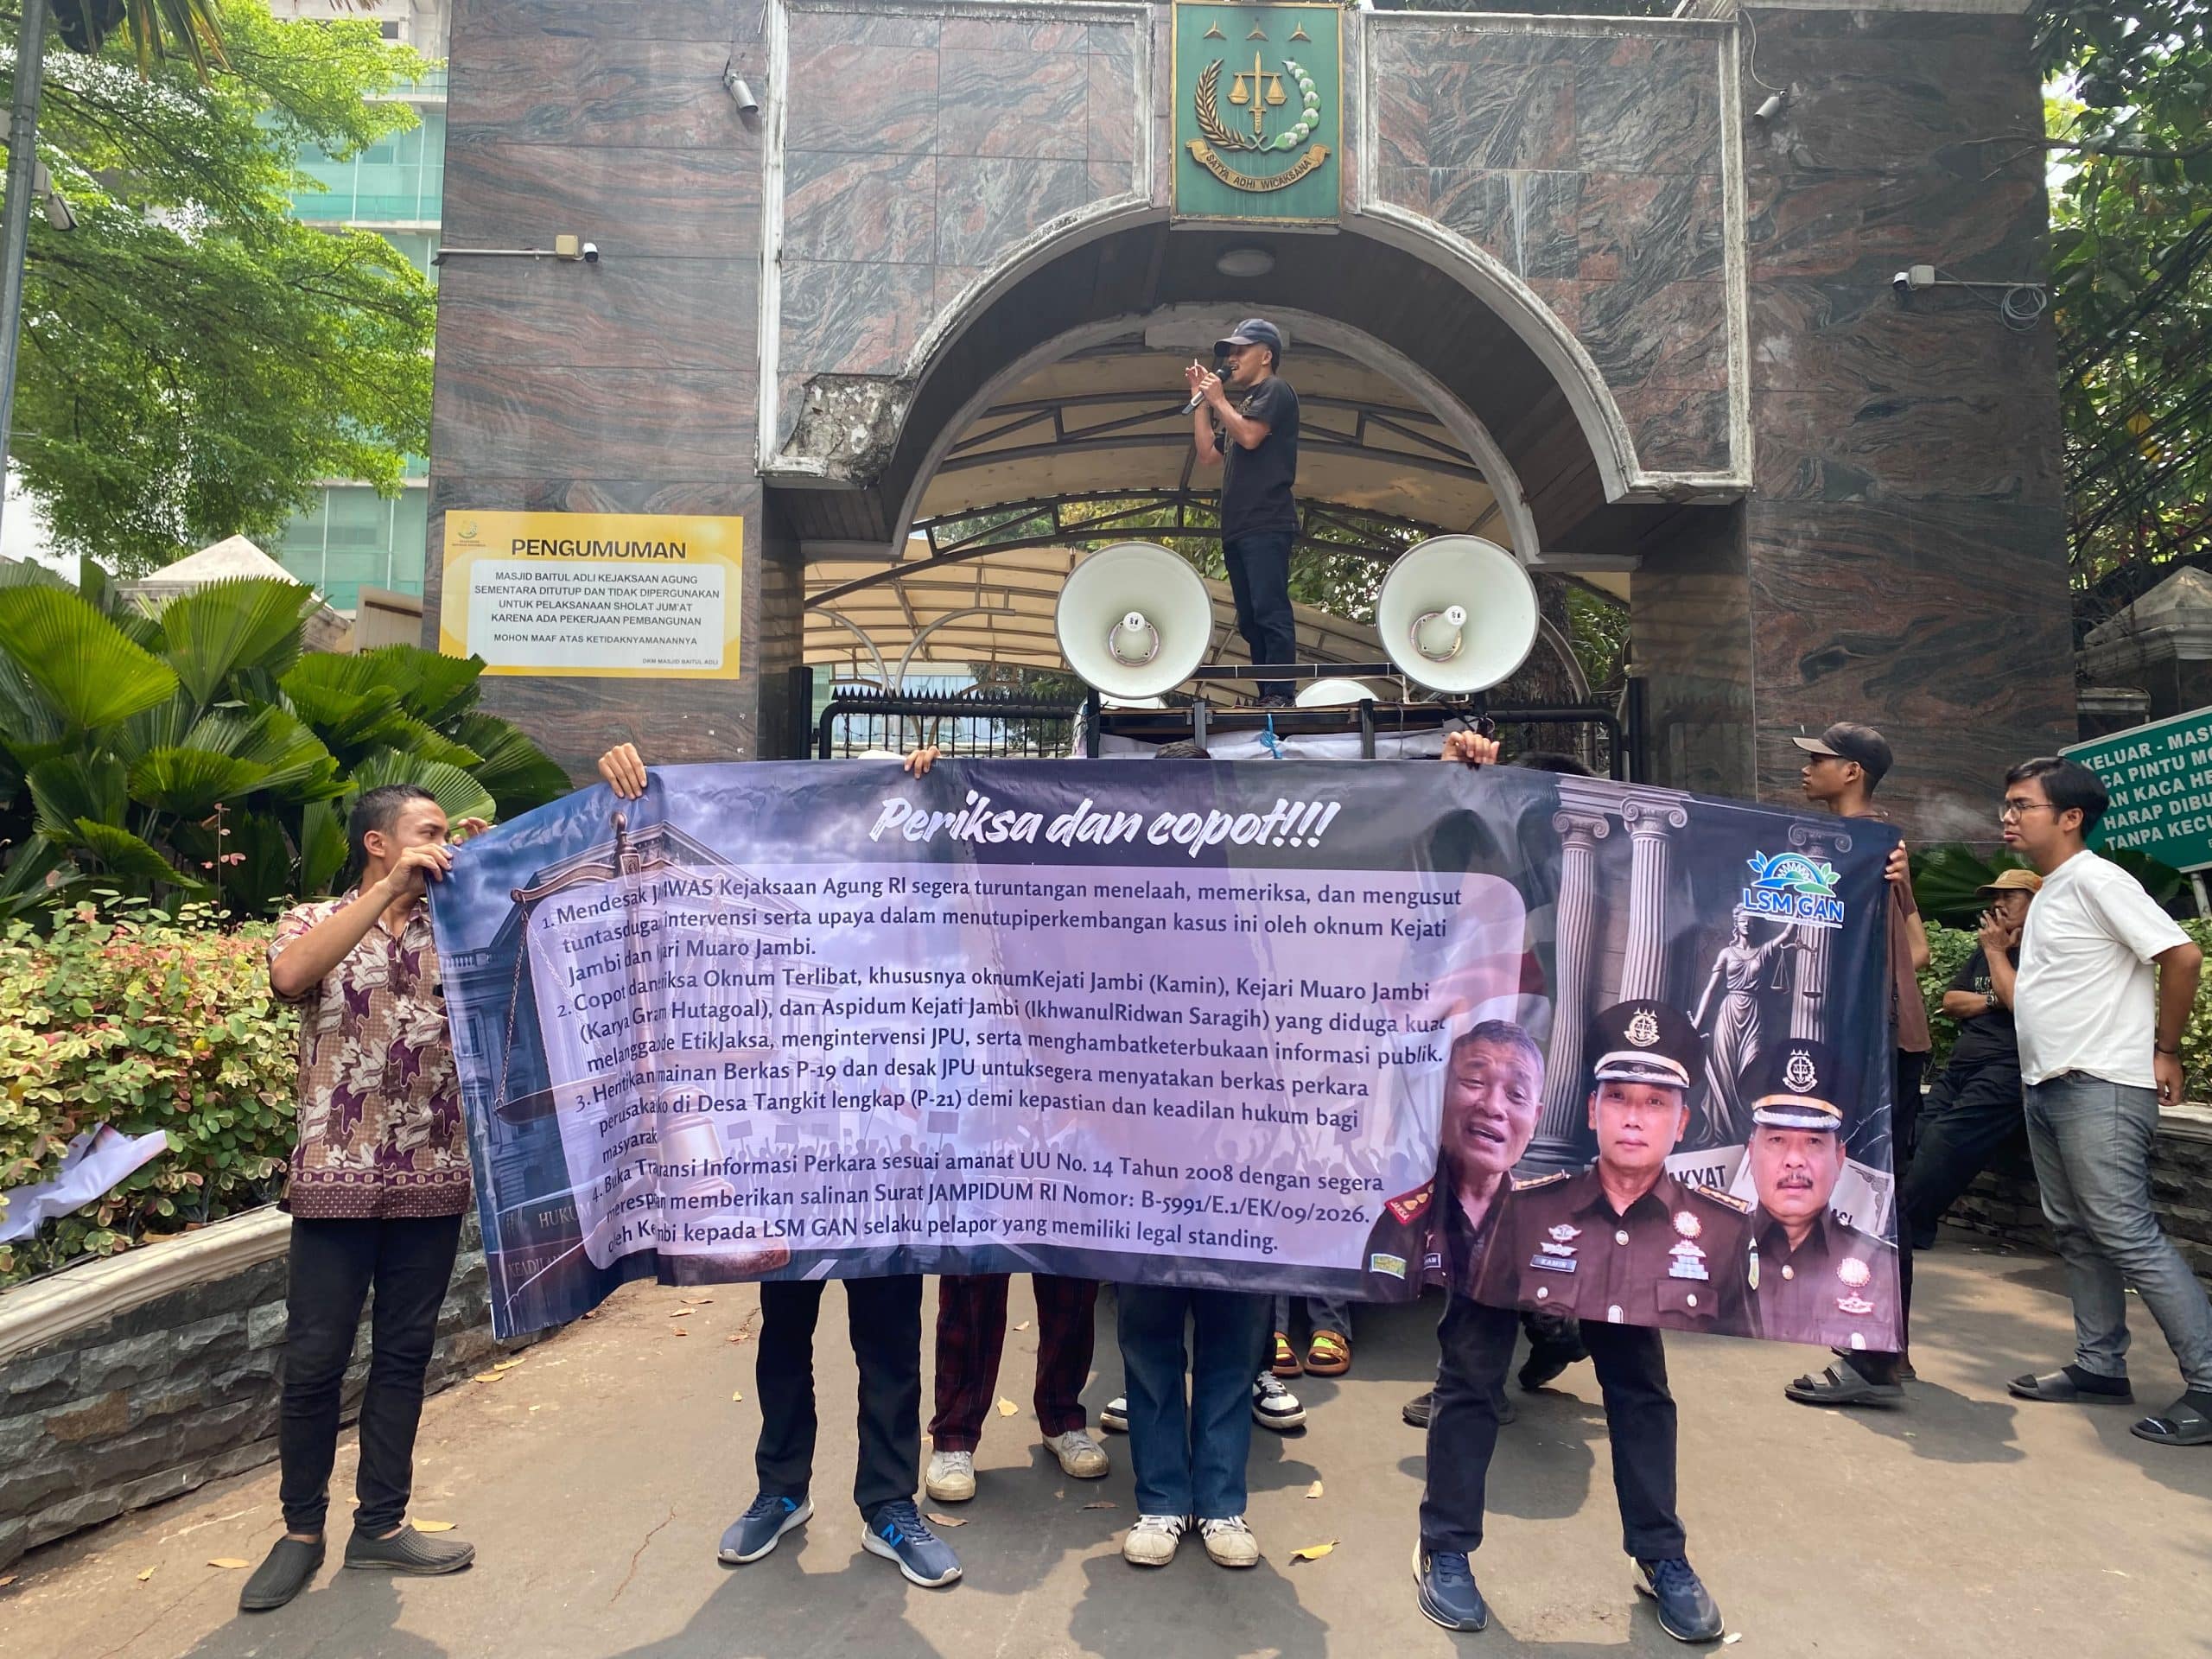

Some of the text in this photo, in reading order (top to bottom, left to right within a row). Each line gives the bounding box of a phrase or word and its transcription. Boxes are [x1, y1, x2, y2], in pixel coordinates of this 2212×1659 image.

[1206, 153, 1311, 189] SATYA ADHI WICAKSANA
[512, 539, 685, 558] PENGUMUMAN
[475, 586, 537, 594] SEMENTARA
[539, 587, 582, 595] DITUTUP
[607, 588, 637, 596] TIDAK
[640, 588, 719, 598] DIPERGUNAKAN
[496, 572, 532, 581] MASJID
[598, 574, 658, 583] KEJAKSAAN
[661, 575, 697, 584] AGUNG
[492, 613, 533, 622] KARENA
[560, 615, 620, 624] PEKERJAAN
[623, 616, 701, 626] PEMBANGUNAN
[499, 600, 533, 608] UNTUK
[537, 601, 611, 610] PELAKSANAAN
[587, 636, 697, 645] KETIDAKNYAMANANNYA
[2167, 726, 2212, 750] MAS
[2128, 754, 2185, 782] PINTU
[2133, 778, 2185, 802] KACA
[869, 790, 1341, 858] Periksa dan copot!!!
[2103, 804, 2163, 830] HARAP
[2105, 827, 2164, 851] TANPA
[543, 877, 1461, 929] 1. Mendesak Kejaksaan Agung RI segera turuntangan menelaah, memeriksa, dan mengusut
[1743, 888, 1793, 914] LSM
[1797, 897, 1844, 922] GAN
[663, 908, 756, 927] intervensi
[764, 907, 812, 925] serta
[819, 912, 875, 929] upaya
[880, 906, 935, 924] dalam
[1174, 912, 1226, 931] kasus
[1235, 914, 1257, 932] ini
[1264, 914, 1306, 933] oleh
[1313, 916, 1382, 936] oknum
[1391, 918, 1446, 941] Kejati
[569, 953, 620, 987] Jambi
[625, 949, 652, 968] dan
[687, 940, 749, 957] Muaro
[754, 938, 816, 960] Jambi.
[556, 1004, 571, 1017] 2.
[575, 986, 626, 1011] Copot
[629, 977, 656, 995] dan
[704, 969, 774, 987] Oknum
[782, 967, 861, 990] Terlibat,
[869, 966, 966, 988] khususnya
[1090, 972, 1142, 993] Jambi
[1150, 975, 1229, 997] (Kamin),
[1237, 977, 1293, 1001] Kejari
[1300, 980, 1366, 999] Muaro
[1371, 982, 1429, 1004] Jambi
[581, 1017, 630, 1044] (Karya
[672, 999, 774, 1022] Hutagoal),
[780, 999, 815, 1016] dan
[823, 996, 906, 1020] Aspidum
[912, 996, 963, 1019] Kejati
[968, 997, 1019, 1019] Jambi
[1189, 1007, 1269, 1031] Saragih)
[1275, 1016, 1323, 1034] yang
[1329, 1012, 1399, 1037] diduga
[1406, 1014, 1446, 1032] kuat
[782, 1027, 925, 1051] mengintervensi
[931, 1027, 969, 1049] JPU,
[976, 1031, 1022, 1046] serta
[1275, 1041, 1369, 1064] informasi
[1378, 1044, 1442, 1069] publik.
[575, 1095, 591, 1112] 3.
[593, 1071, 658, 1103] Hentikan
[724, 1061, 790, 1080] Berkas
[797, 1061, 836, 1082] P-19
[842, 1057, 877, 1077] dan
[885, 1058, 937, 1076] desak
[941, 1058, 975, 1080] JPU
[1099, 1068, 1213, 1089] menyatakan
[1221, 1070, 1285, 1091] berkas
[1293, 1076, 1369, 1097] perkara
[673, 1088, 1357, 1132] di Desa Tangkit lengkap (P-21) demi kepastian dan keadilan hukum bagi
[593, 1151, 1384, 1203] 4. Buka Informasi Perkara sesuai amanat UU No. 14 Tahun 2008 dengan segera
[671, 1187, 793, 1210] memberikan
[801, 1185, 868, 1205] salinan
[875, 1184, 924, 1201] Surat
[928, 1183, 1033, 1205] JAMPIDUM
[1040, 1183, 1056, 1201] RI
[1064, 1185, 1134, 1207] Nomor:
[1142, 1190, 1369, 1224] B-5991/E.1/EK/09/2026.
[608, 1213, 1277, 1254] oleh kepada LSM GAN selaku pelapor yang memiliki legal standing.
